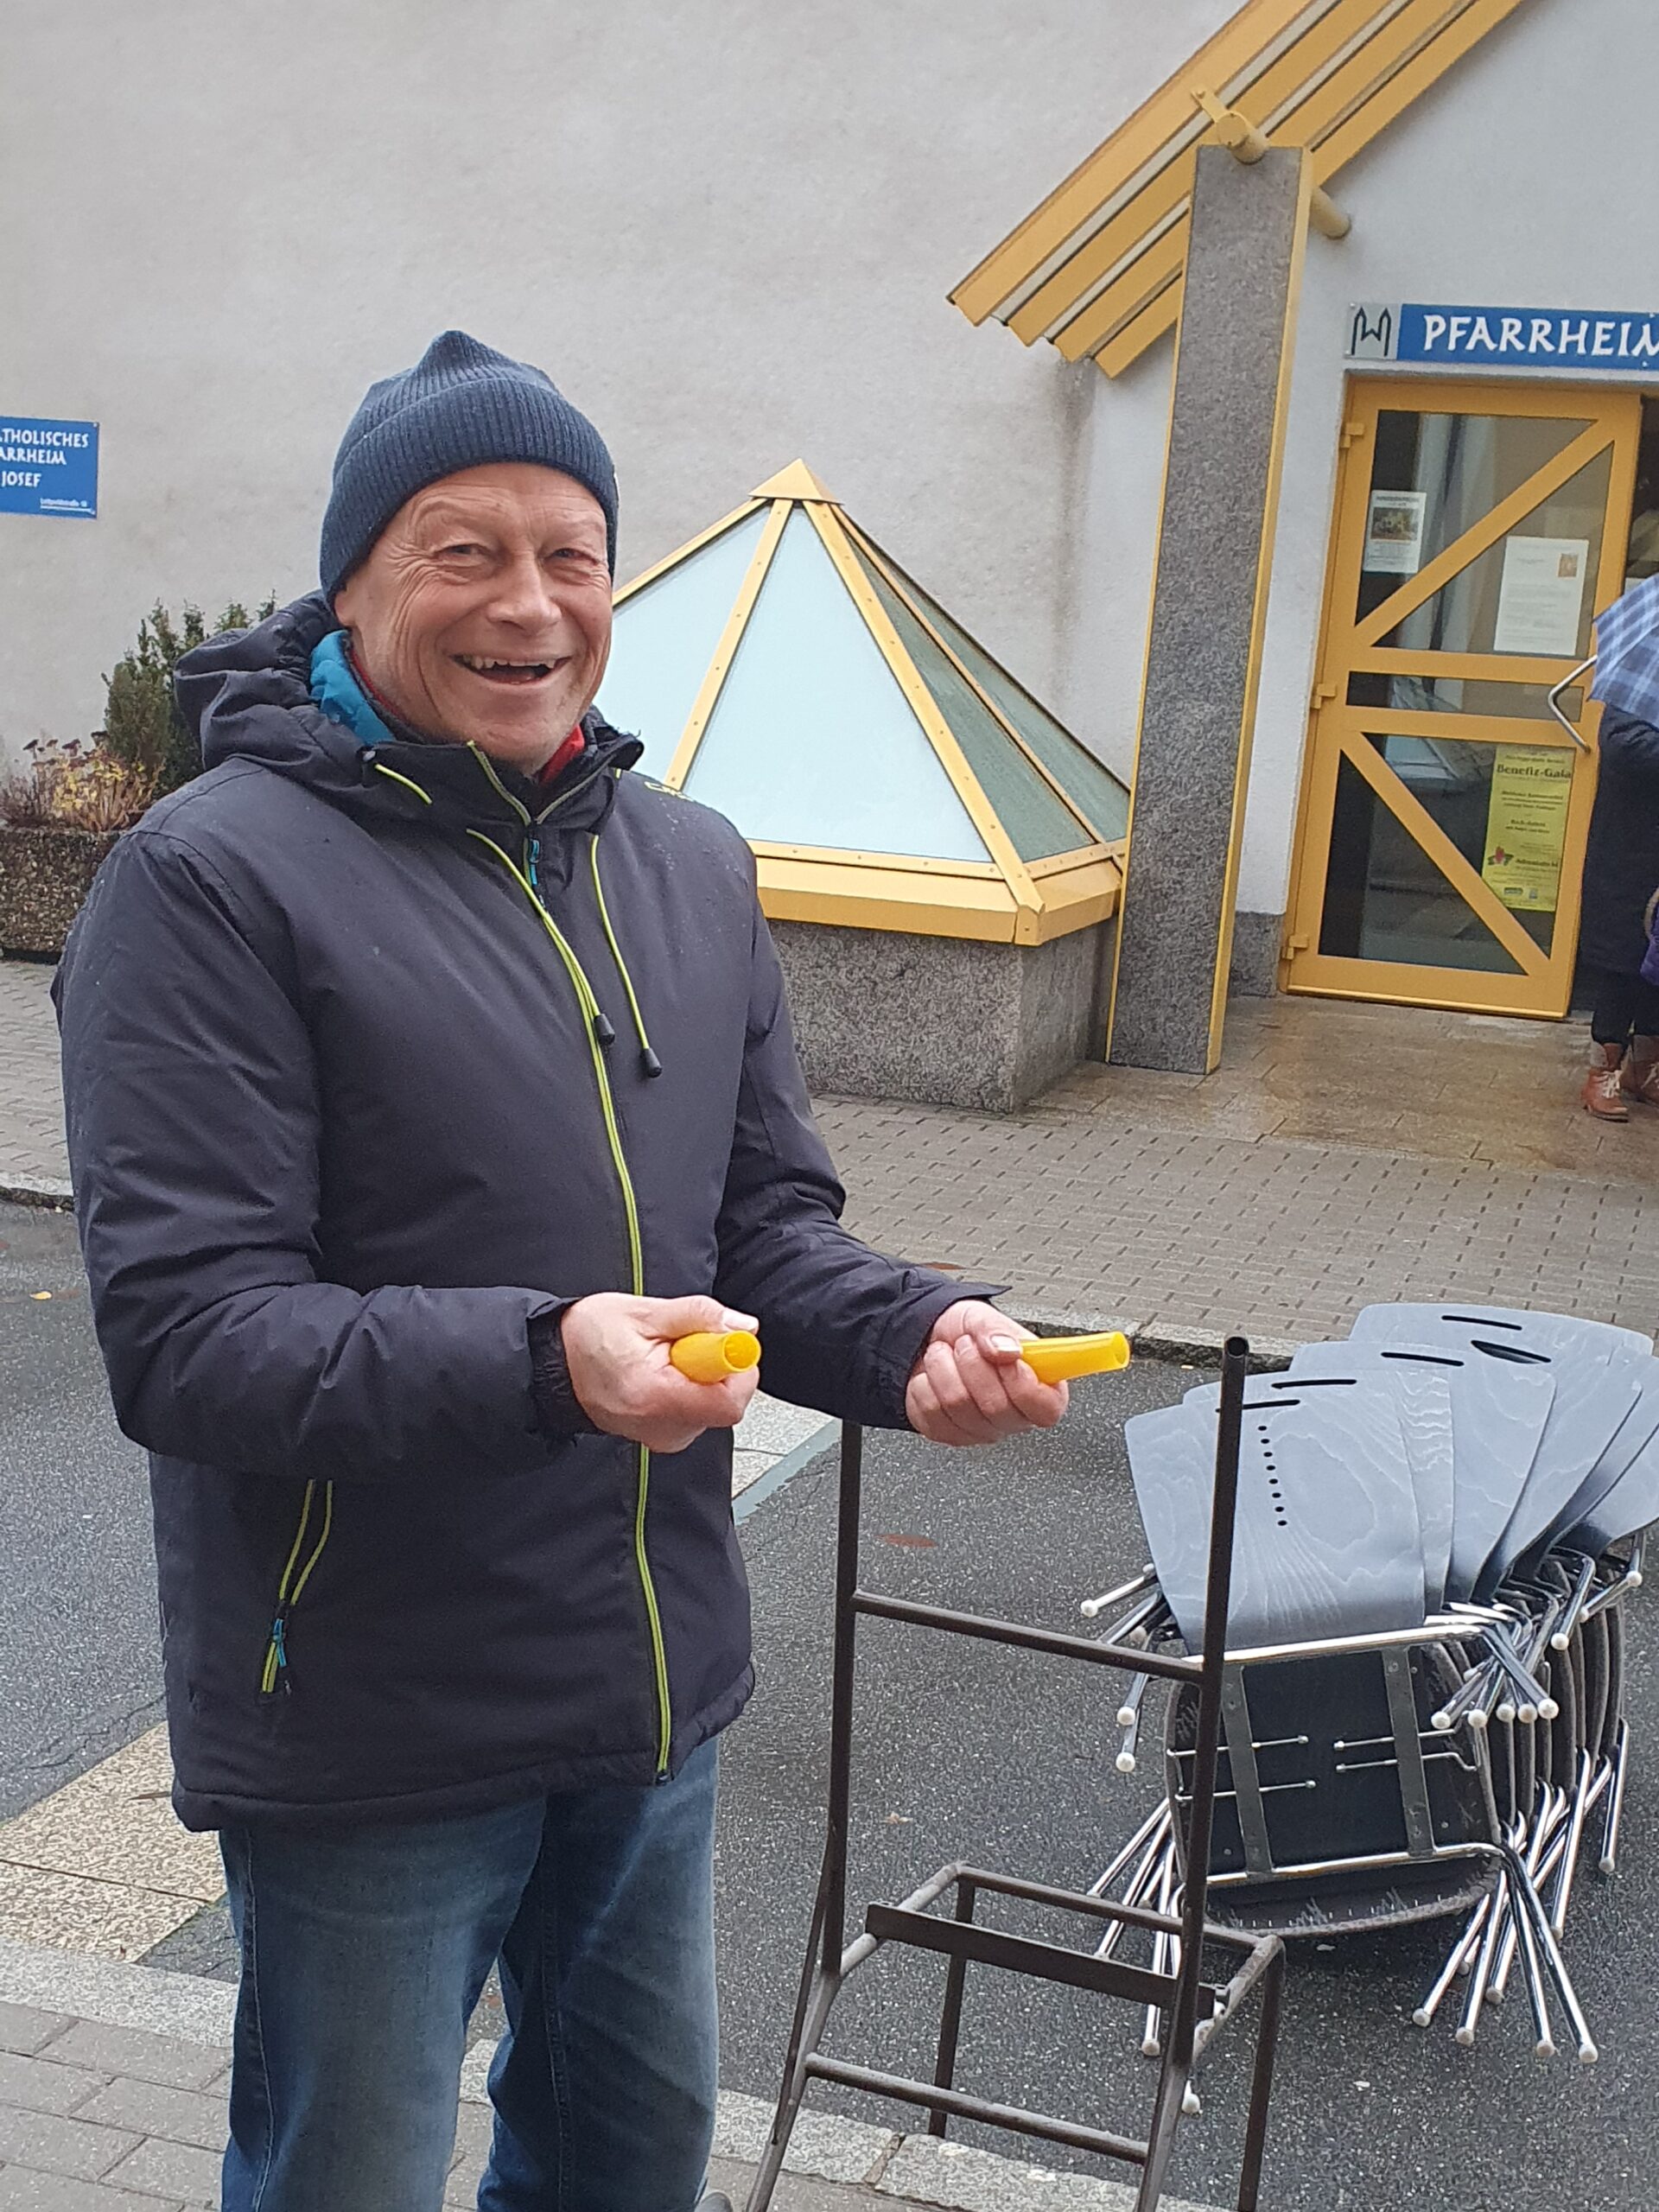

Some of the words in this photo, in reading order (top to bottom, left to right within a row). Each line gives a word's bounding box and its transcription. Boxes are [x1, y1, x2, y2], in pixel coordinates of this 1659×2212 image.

[0, 428, 89, 448] THOLISCHES
[1, 471, 42, 488] JOSEF
[1497, 764, 1572, 779] Benefiz-Gala
